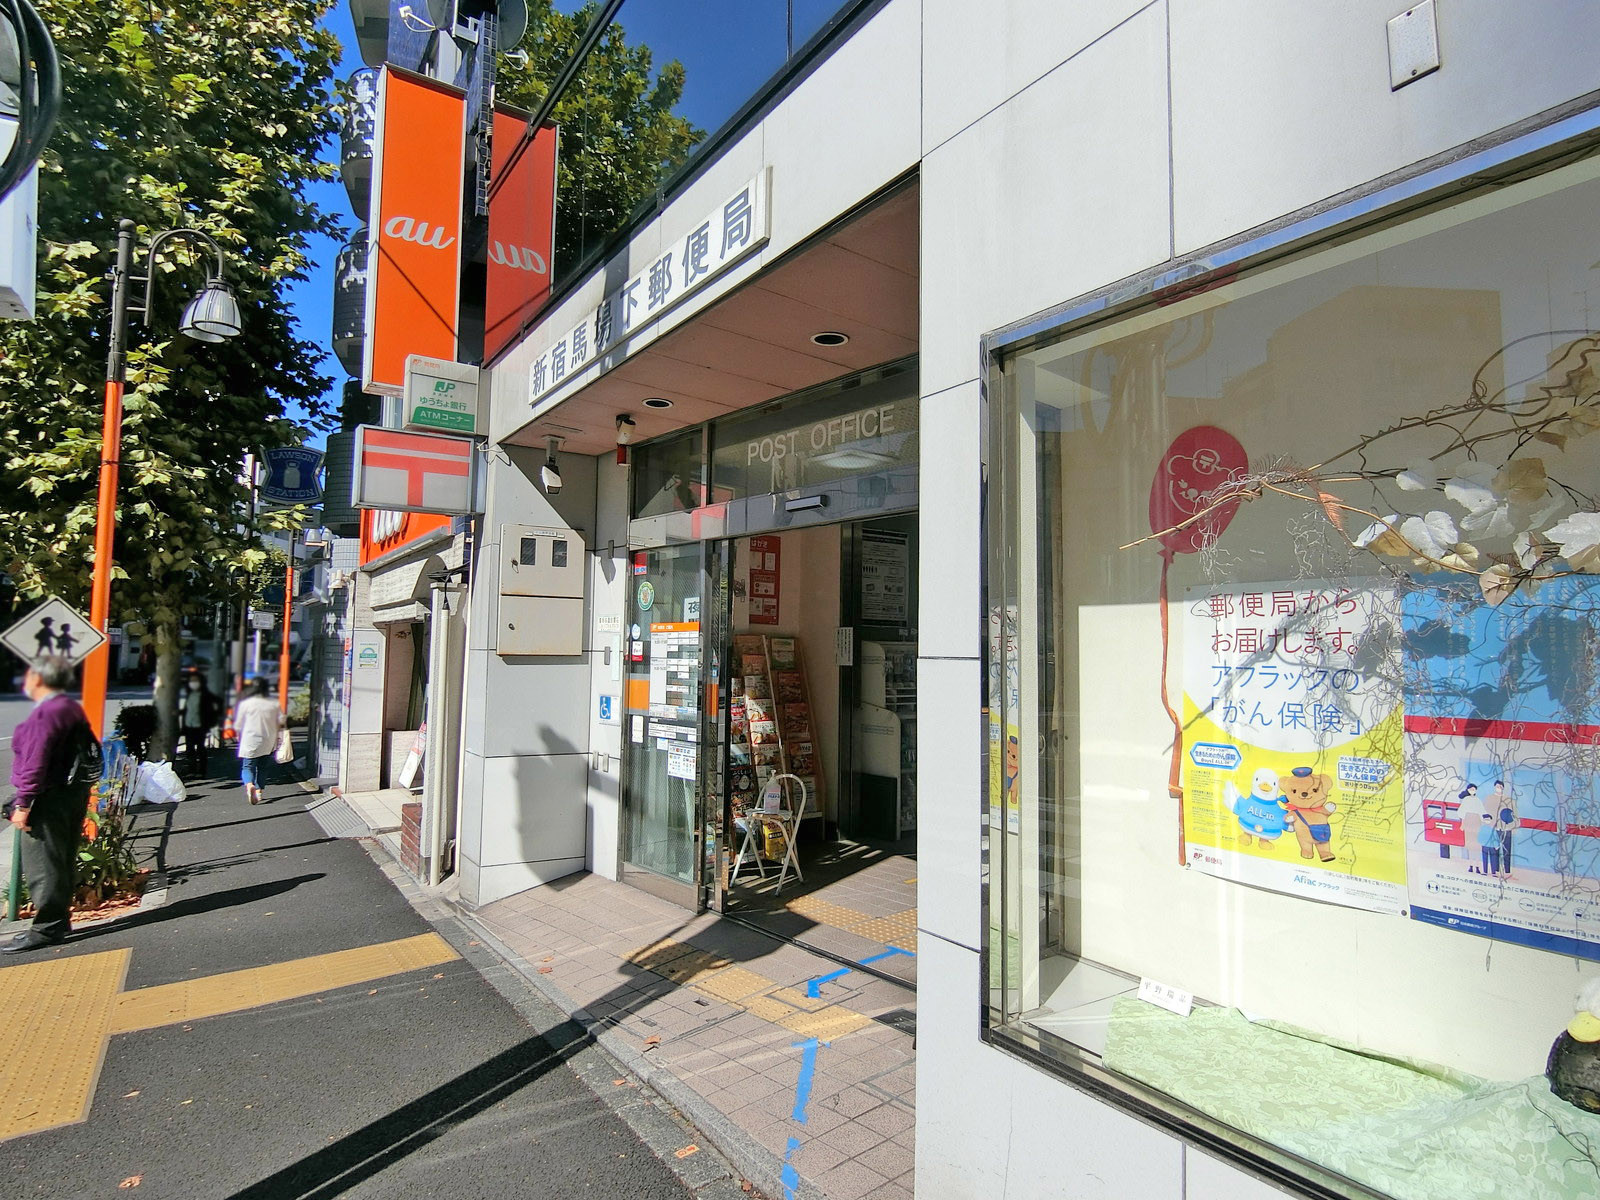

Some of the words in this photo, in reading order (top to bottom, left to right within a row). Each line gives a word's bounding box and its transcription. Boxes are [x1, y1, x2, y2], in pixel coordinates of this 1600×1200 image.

[385, 216, 456, 250] au
[532, 187, 752, 397] 新宿馬場下郵便局
[434, 381, 456, 393] JP
[419, 396, 468, 411] ゆうちょ銀行
[420, 410, 471, 423] ATMコーナー
[747, 430, 801, 466] POST
[810, 405, 895, 450] OFFICE
[271, 450, 317, 463] LAWSON
[266, 486, 315, 498] STATION
[1210, 588, 1357, 619] 郵便局から
[1211, 626, 1359, 655] お届けします。
[1211, 665, 1360, 692] アフラックの
[1211, 696, 1361, 736] 「がん保険」
[1340, 764, 1385, 775] 生きるための
[1344, 771, 1378, 782] がん保険
[1247, 805, 1275, 821] ALL-in
[1293, 874, 1317, 887] Aflac
